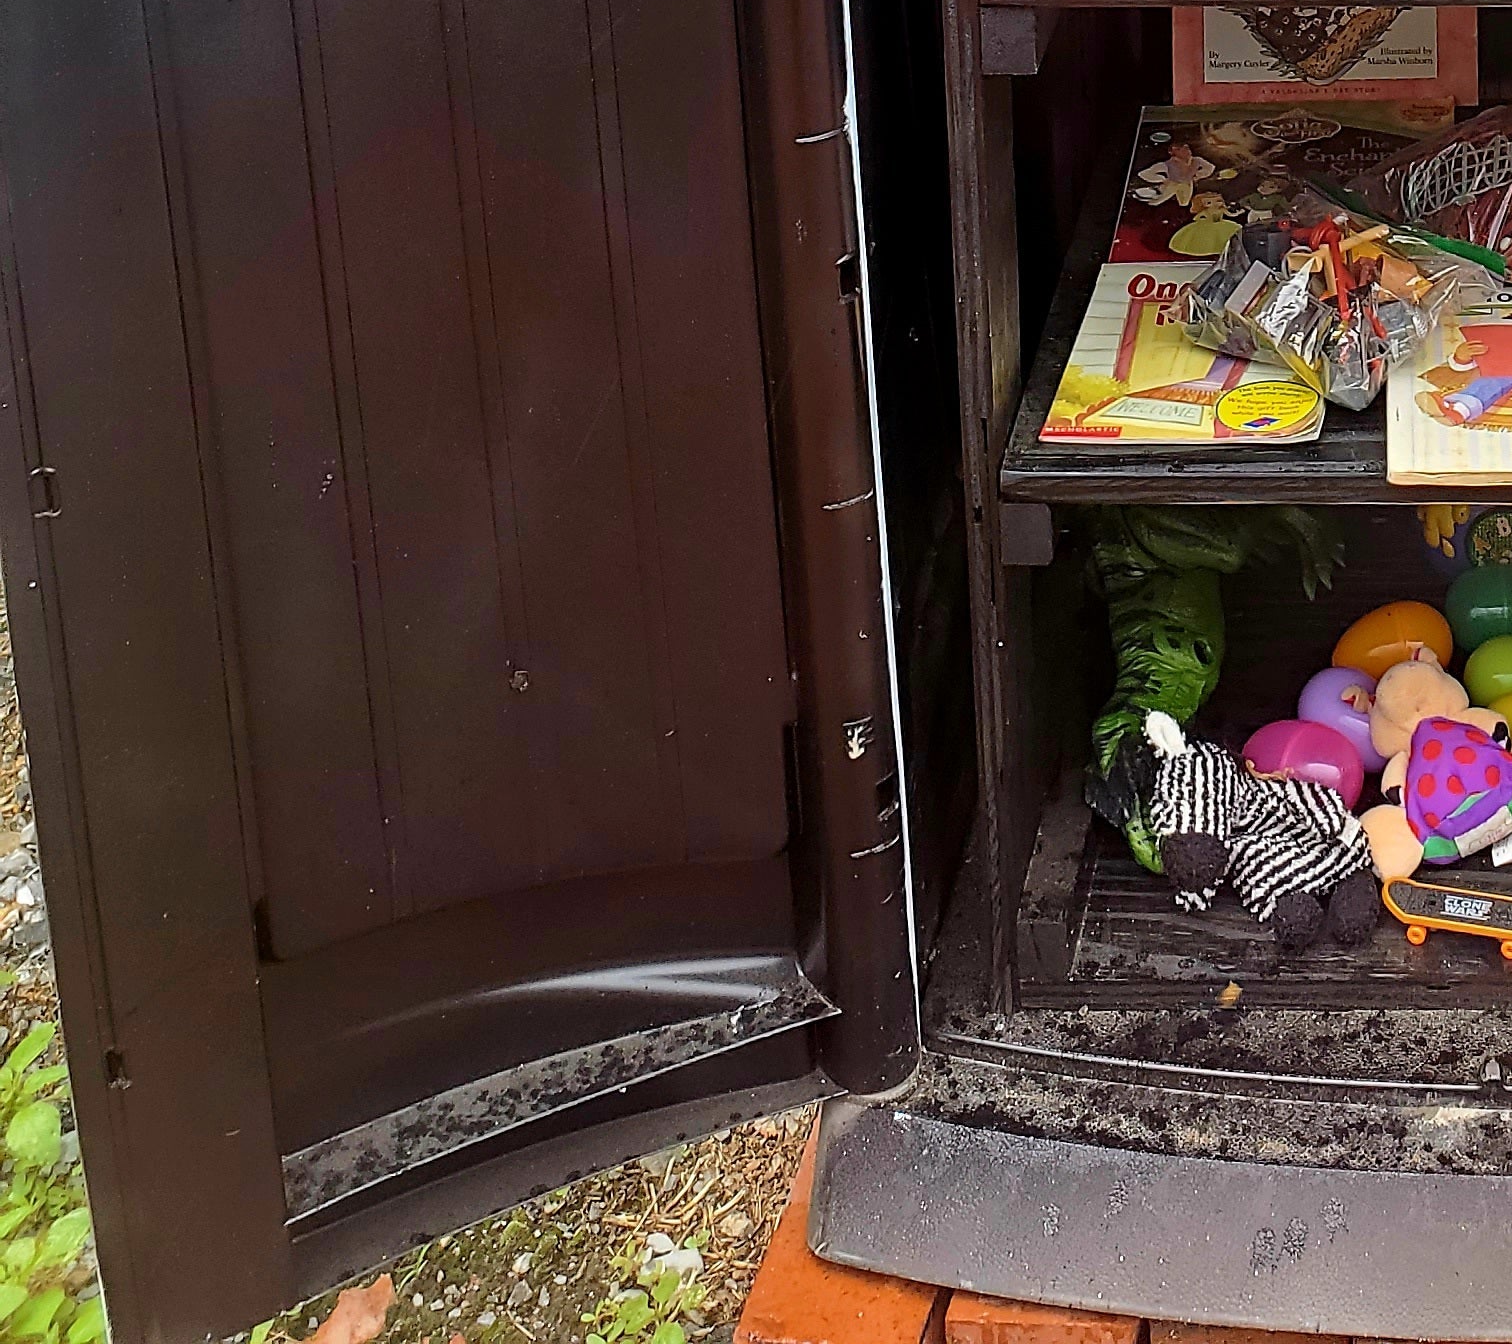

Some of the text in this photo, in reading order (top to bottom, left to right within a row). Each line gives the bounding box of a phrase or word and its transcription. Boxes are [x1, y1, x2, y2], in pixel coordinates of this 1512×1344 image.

[1209, 50, 1219, 59] By
[1380, 47, 1432, 56] Illustrated by
[1209, 60, 1241, 69] Margery
[1115, 397, 1197, 419] WELCOME
[1444, 897, 1492, 911] CLONE
